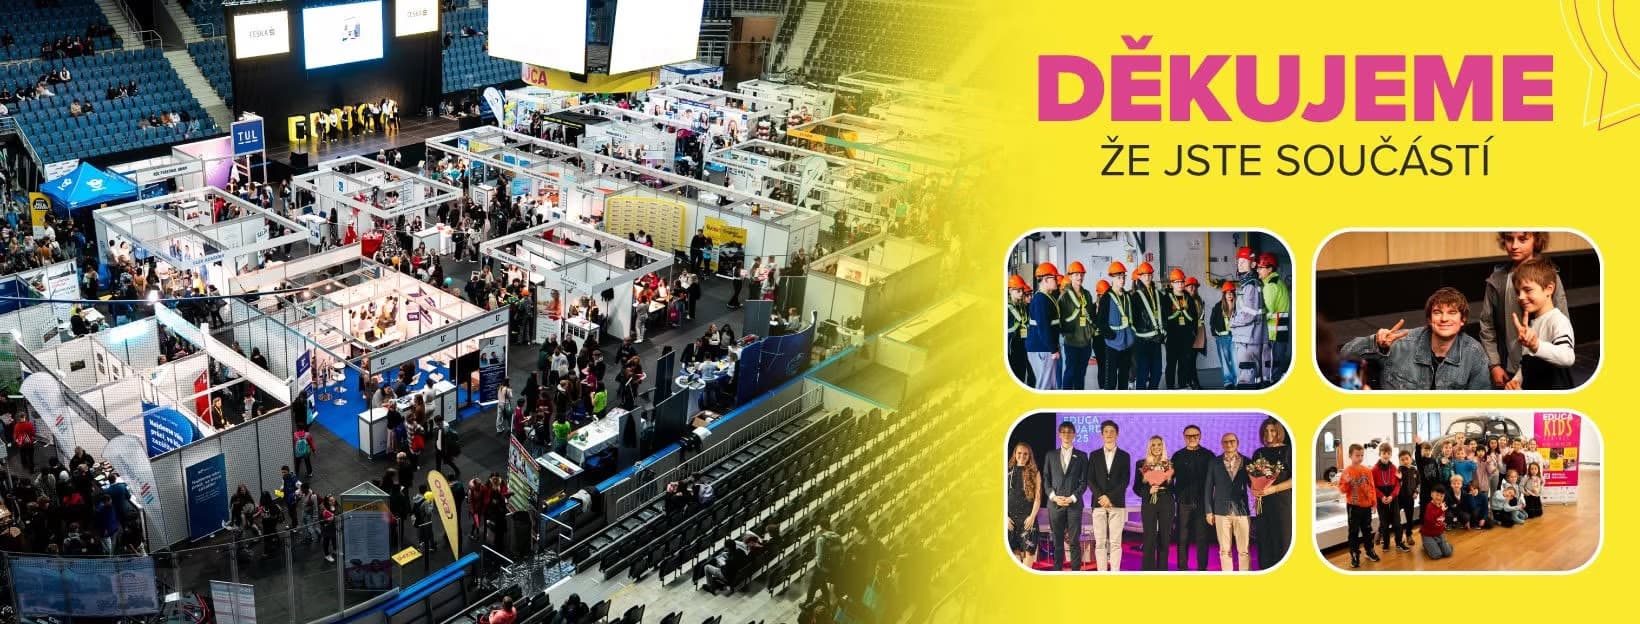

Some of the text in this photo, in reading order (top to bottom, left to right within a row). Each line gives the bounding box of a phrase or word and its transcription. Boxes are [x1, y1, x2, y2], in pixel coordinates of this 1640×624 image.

[237, 130, 258, 142] TUL
[1063, 415, 1099, 425] EDUCA
[1544, 419, 1573, 437] KIDS
